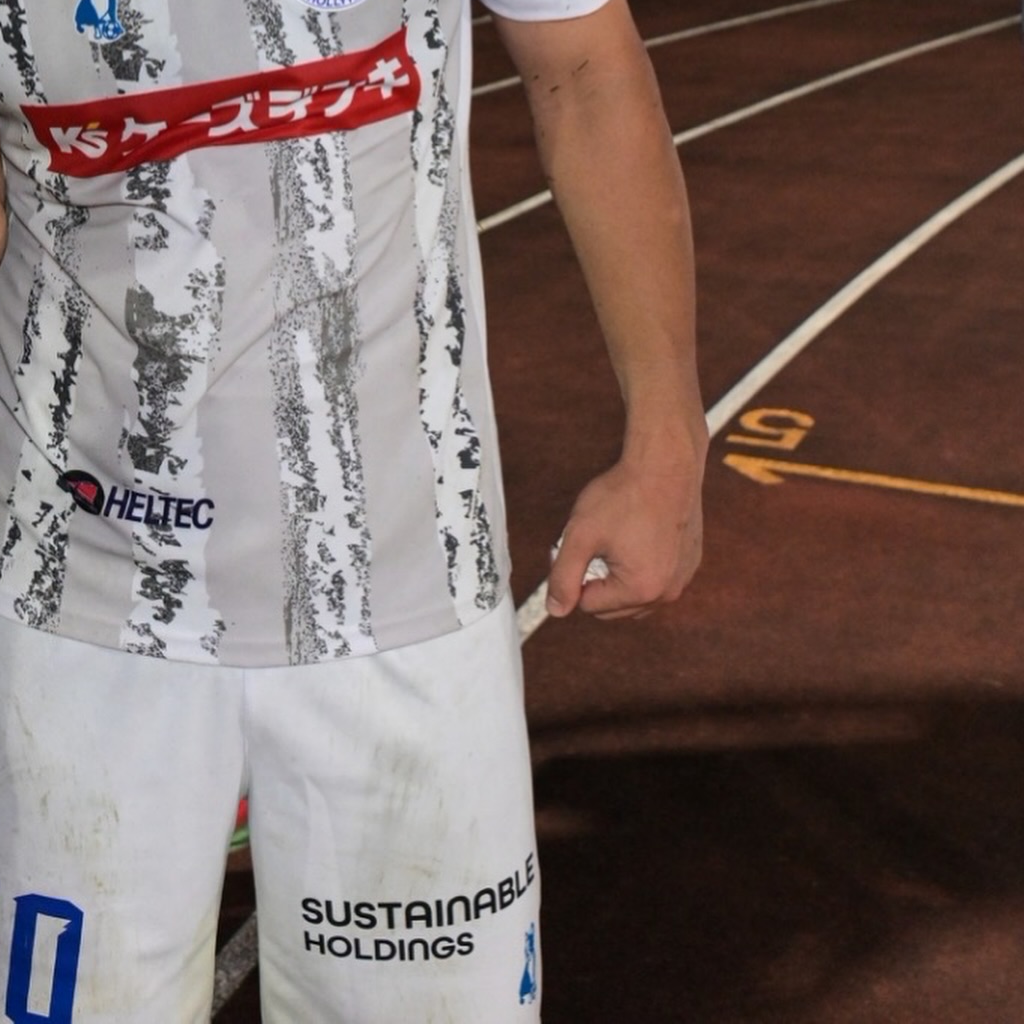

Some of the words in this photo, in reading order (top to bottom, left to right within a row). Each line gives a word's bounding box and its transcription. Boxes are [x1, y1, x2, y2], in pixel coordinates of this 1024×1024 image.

[725, 408, 814, 451] 5
[103, 485, 215, 530] HELTEC
[301, 852, 535, 930] SUSTAINABLE
[304, 931, 474, 962] HOLDINGS
